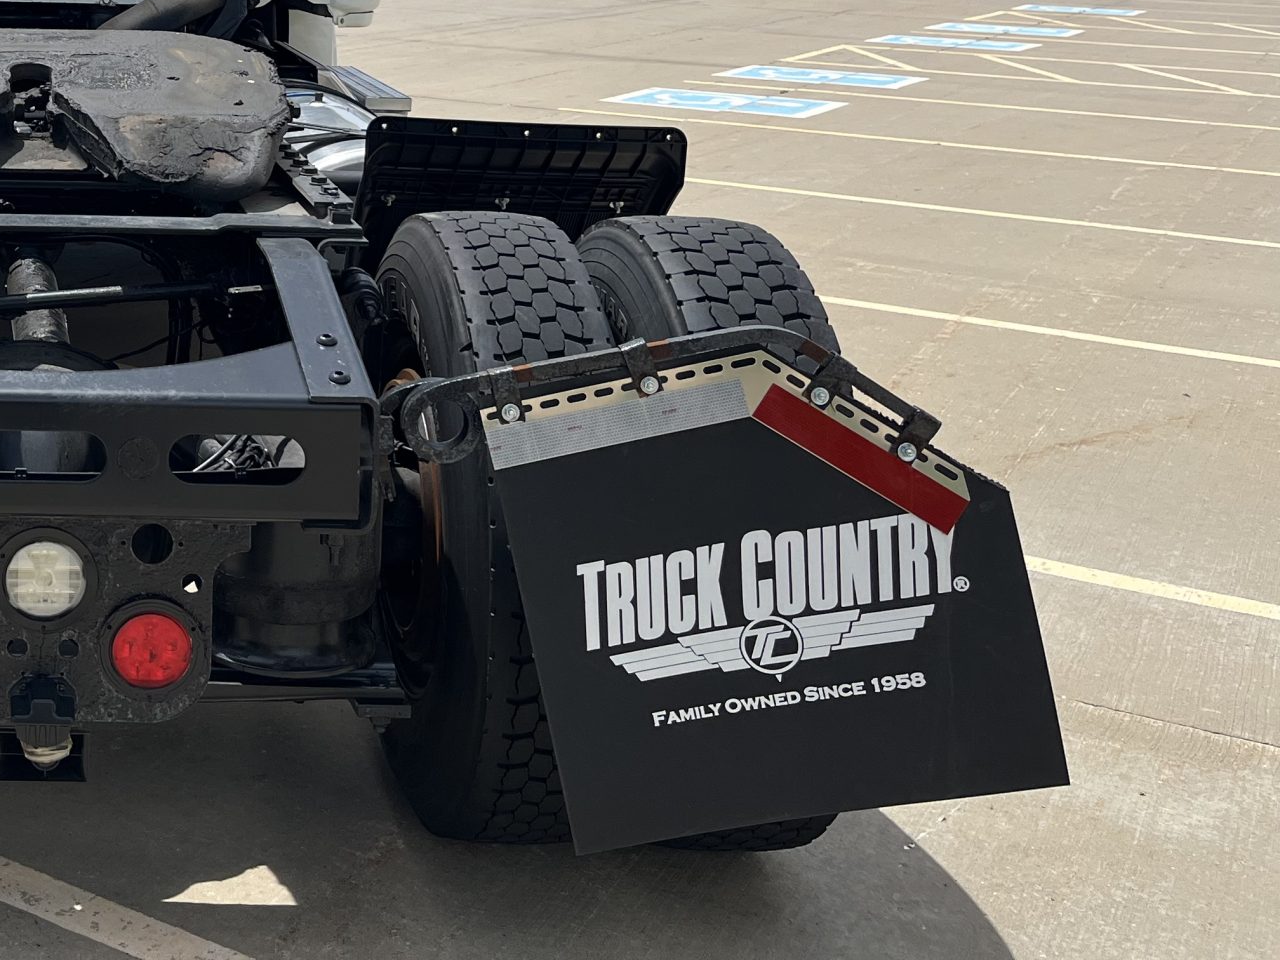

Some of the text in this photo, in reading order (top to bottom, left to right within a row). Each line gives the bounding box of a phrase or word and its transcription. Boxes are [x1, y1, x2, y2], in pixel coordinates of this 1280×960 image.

[577, 542, 728, 652] TRUCK
[652, 671, 926, 727] FAMILY OWNED SINCE 1958
